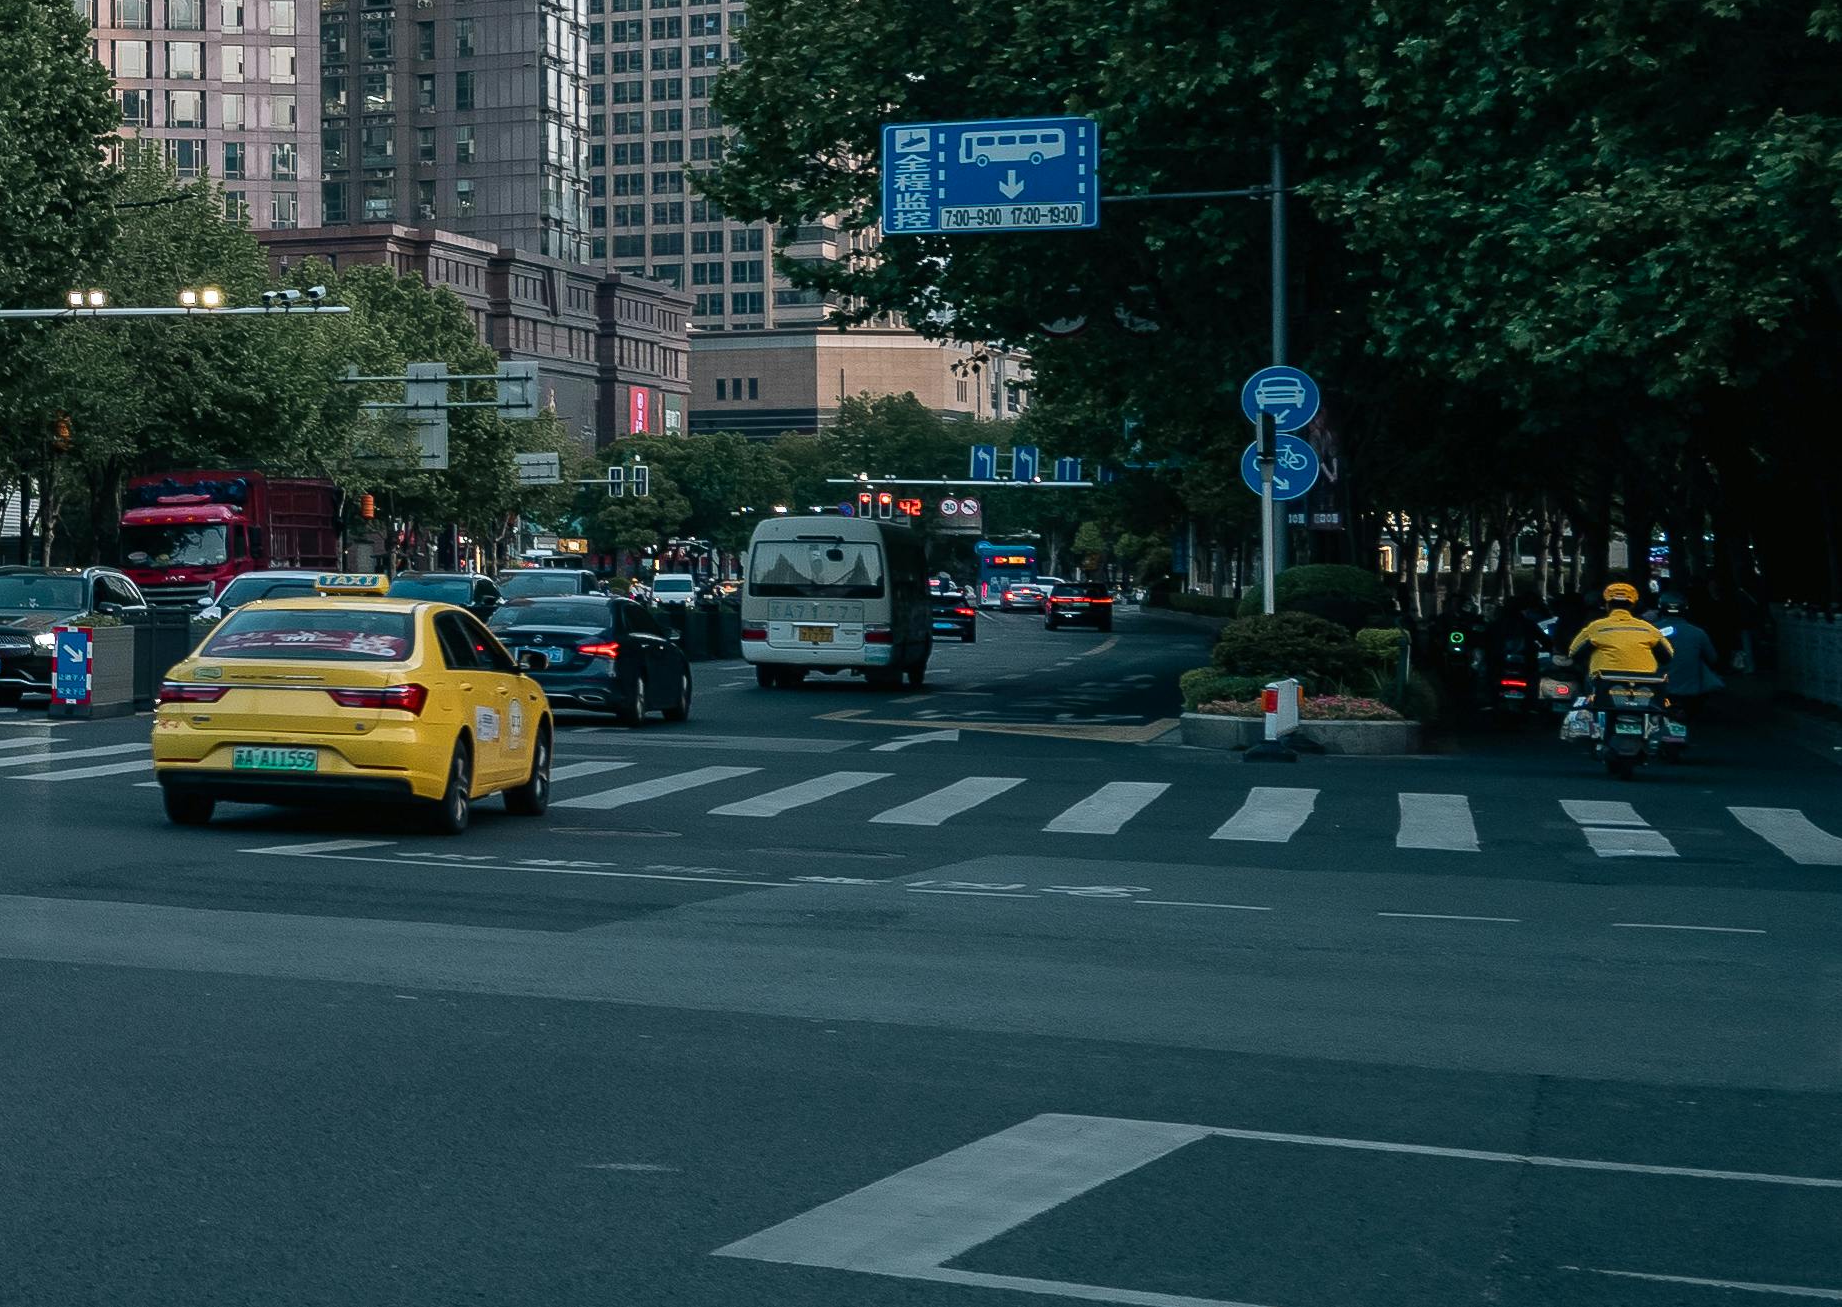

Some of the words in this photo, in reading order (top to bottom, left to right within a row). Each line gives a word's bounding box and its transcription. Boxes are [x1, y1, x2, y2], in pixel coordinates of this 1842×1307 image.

[892, 154, 932, 230] 全程监控
[898, 499, 921, 516] 42
[943, 502, 956, 512] 30
[325, 574, 373, 586] TAXI
